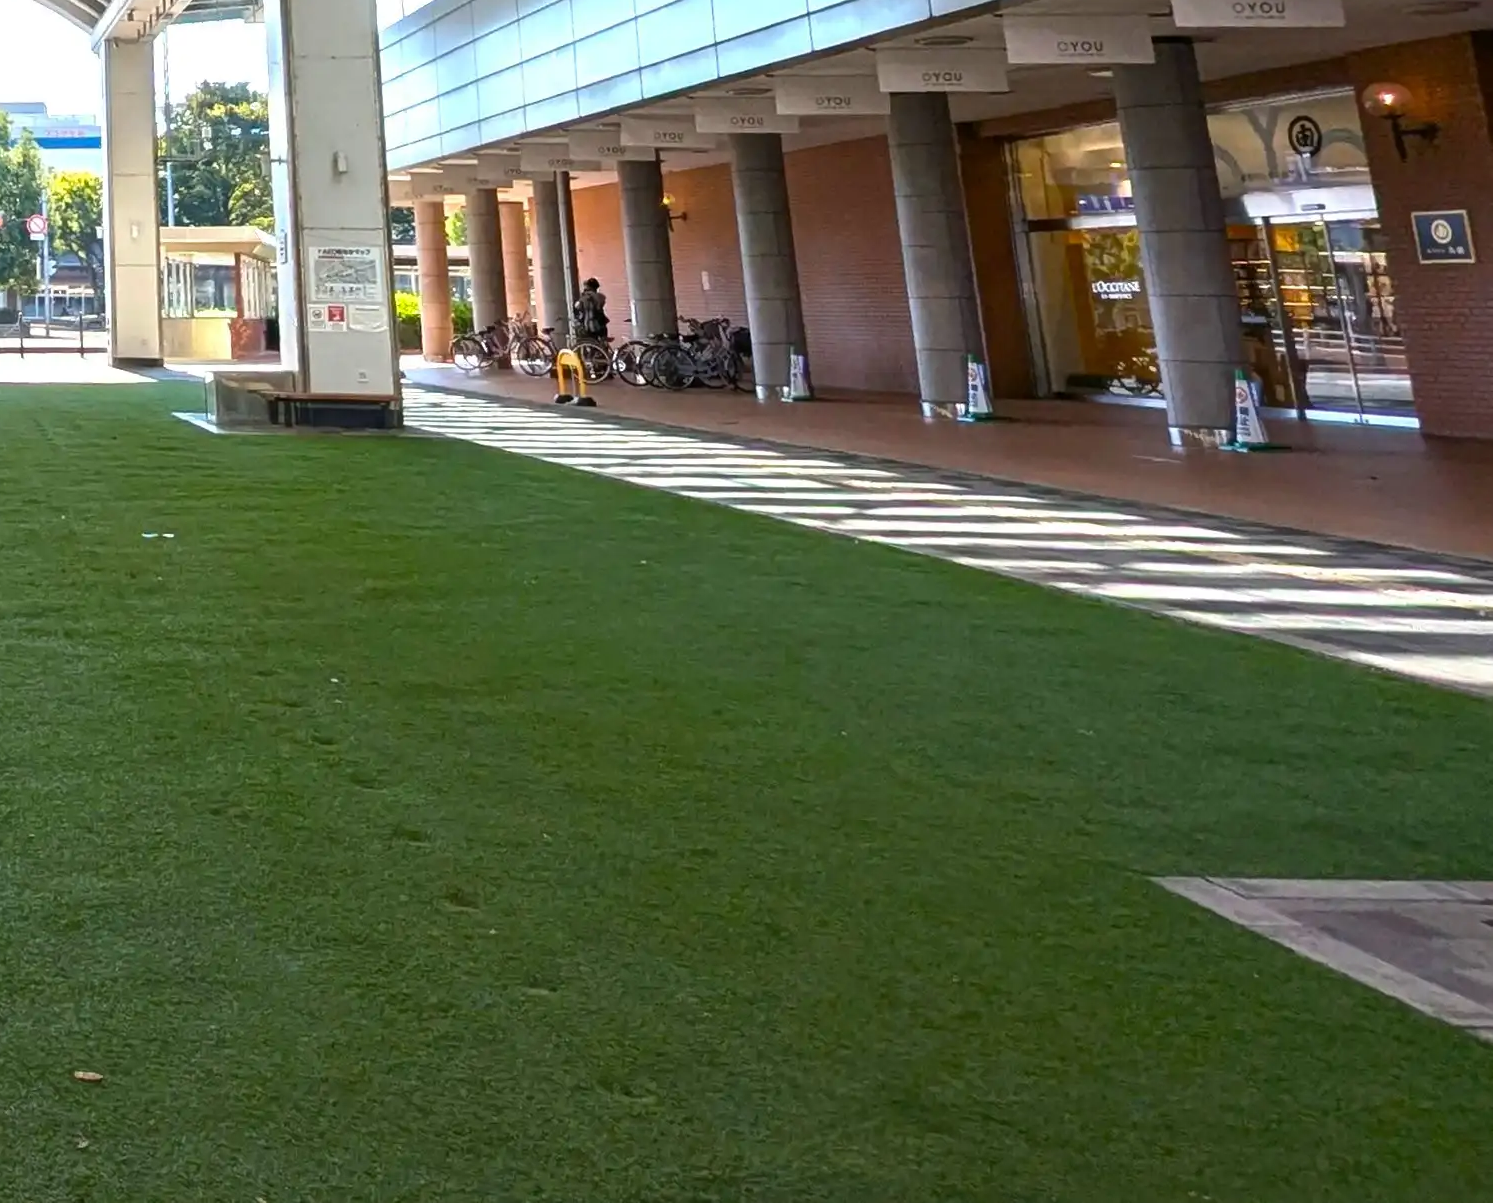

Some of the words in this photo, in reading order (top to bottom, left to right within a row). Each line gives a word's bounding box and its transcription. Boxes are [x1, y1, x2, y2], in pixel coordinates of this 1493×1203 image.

[1232, 1, 1285, 14] OYOU
[1056, 40, 1104, 52] OYOU
[922, 71, 962, 82] OYOU
[816, 97, 852, 106] OYOU
[730, 116, 764, 126] OYOU
[654, 131, 684, 141] OYOU
